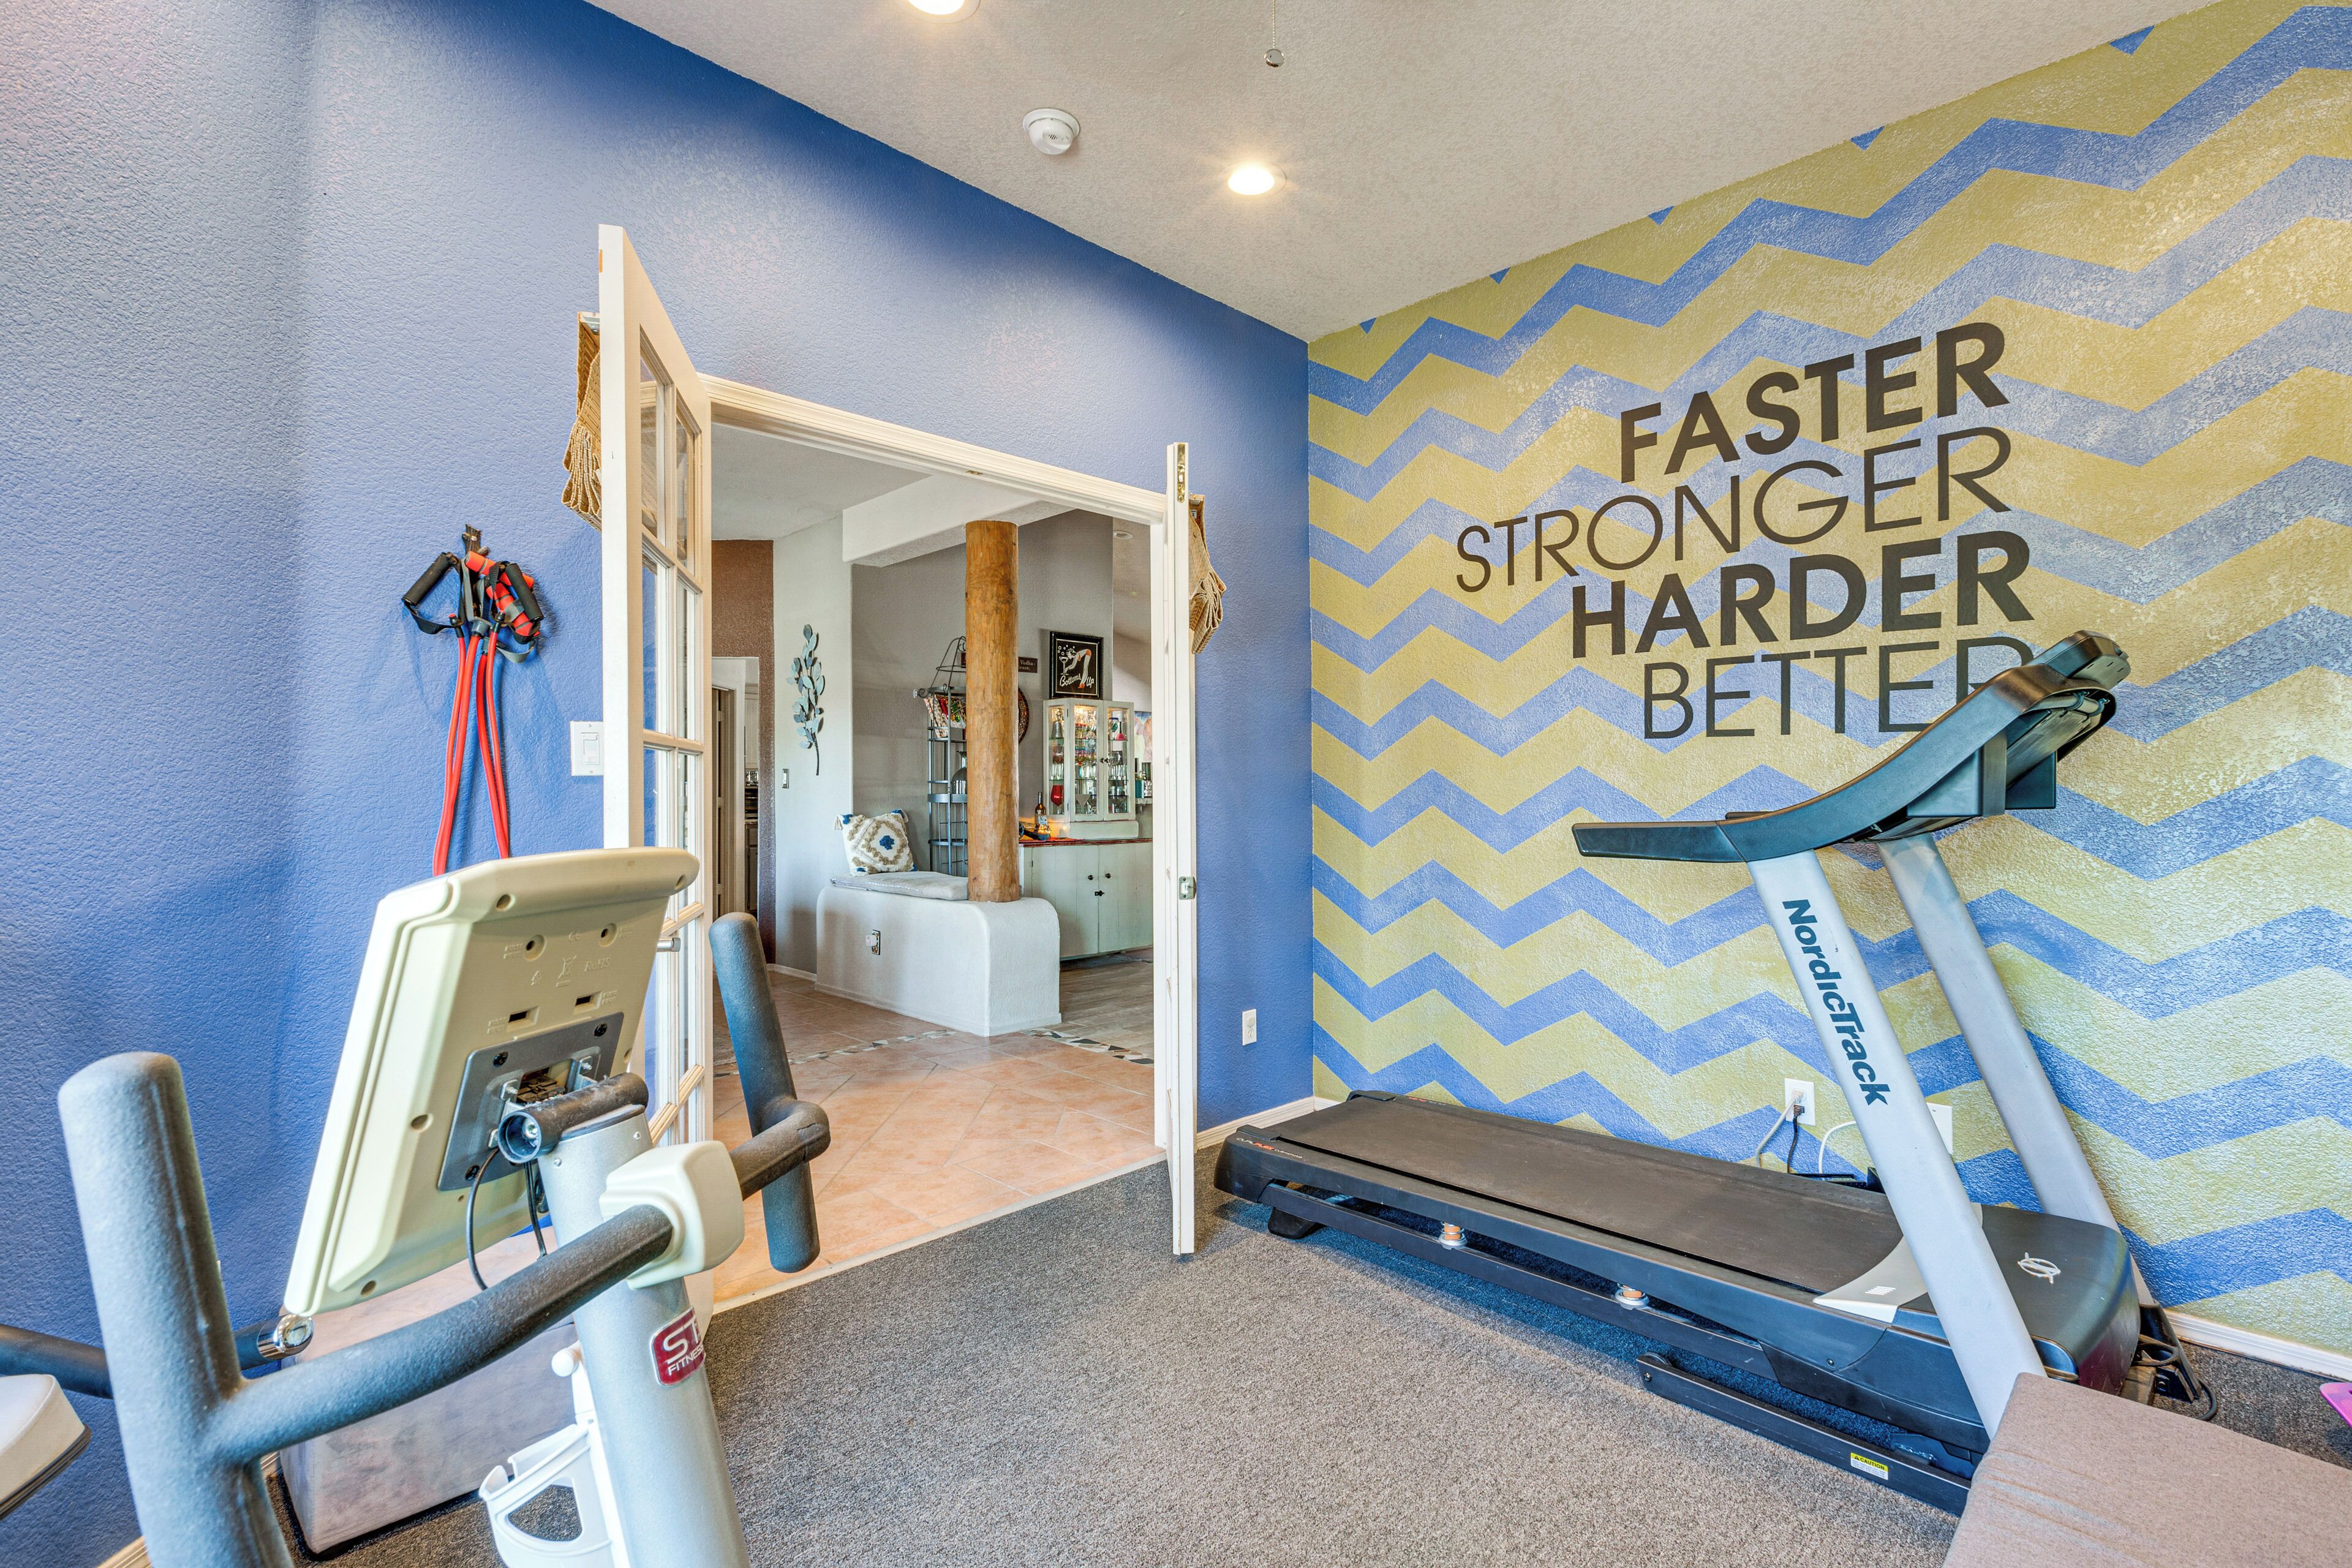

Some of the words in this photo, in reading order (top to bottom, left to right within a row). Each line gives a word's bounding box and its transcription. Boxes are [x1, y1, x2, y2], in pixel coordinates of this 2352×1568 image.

[1621, 321, 2010, 483] FASTER
[1456, 426, 2011, 593] STRONGER
[1572, 530, 2034, 658] HARDER
[1060, 673, 1082, 687] Bottoms
[1086, 676, 1095, 688] Up
[583, 957, 611, 972] RoHS
[1782, 899, 1891, 1106] NordicTrack
[667, 1341, 704, 1376] FITNES
[1860, 1457, 1885, 1471] CAUTION
